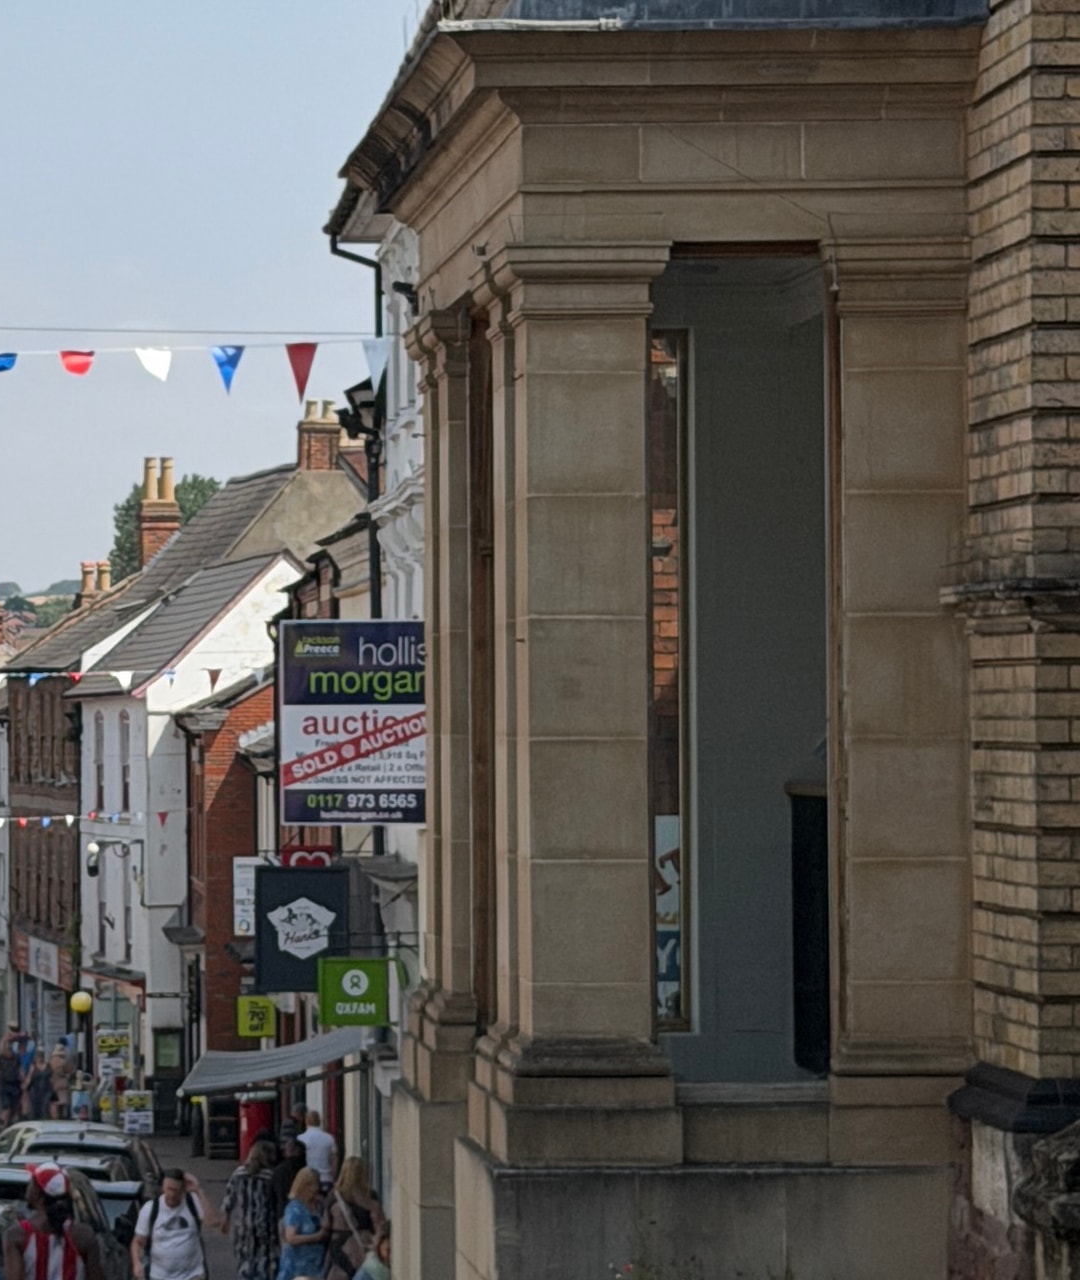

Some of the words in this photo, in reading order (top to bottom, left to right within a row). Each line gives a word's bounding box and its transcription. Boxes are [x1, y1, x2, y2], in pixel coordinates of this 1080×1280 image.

[291, 750, 339, 778] SOLD
[307, 794, 342, 808] 0117
[347, 794, 376, 808] 973
[379, 794, 417, 808] 6565
[336, 1003, 376, 1015] OXFAM
